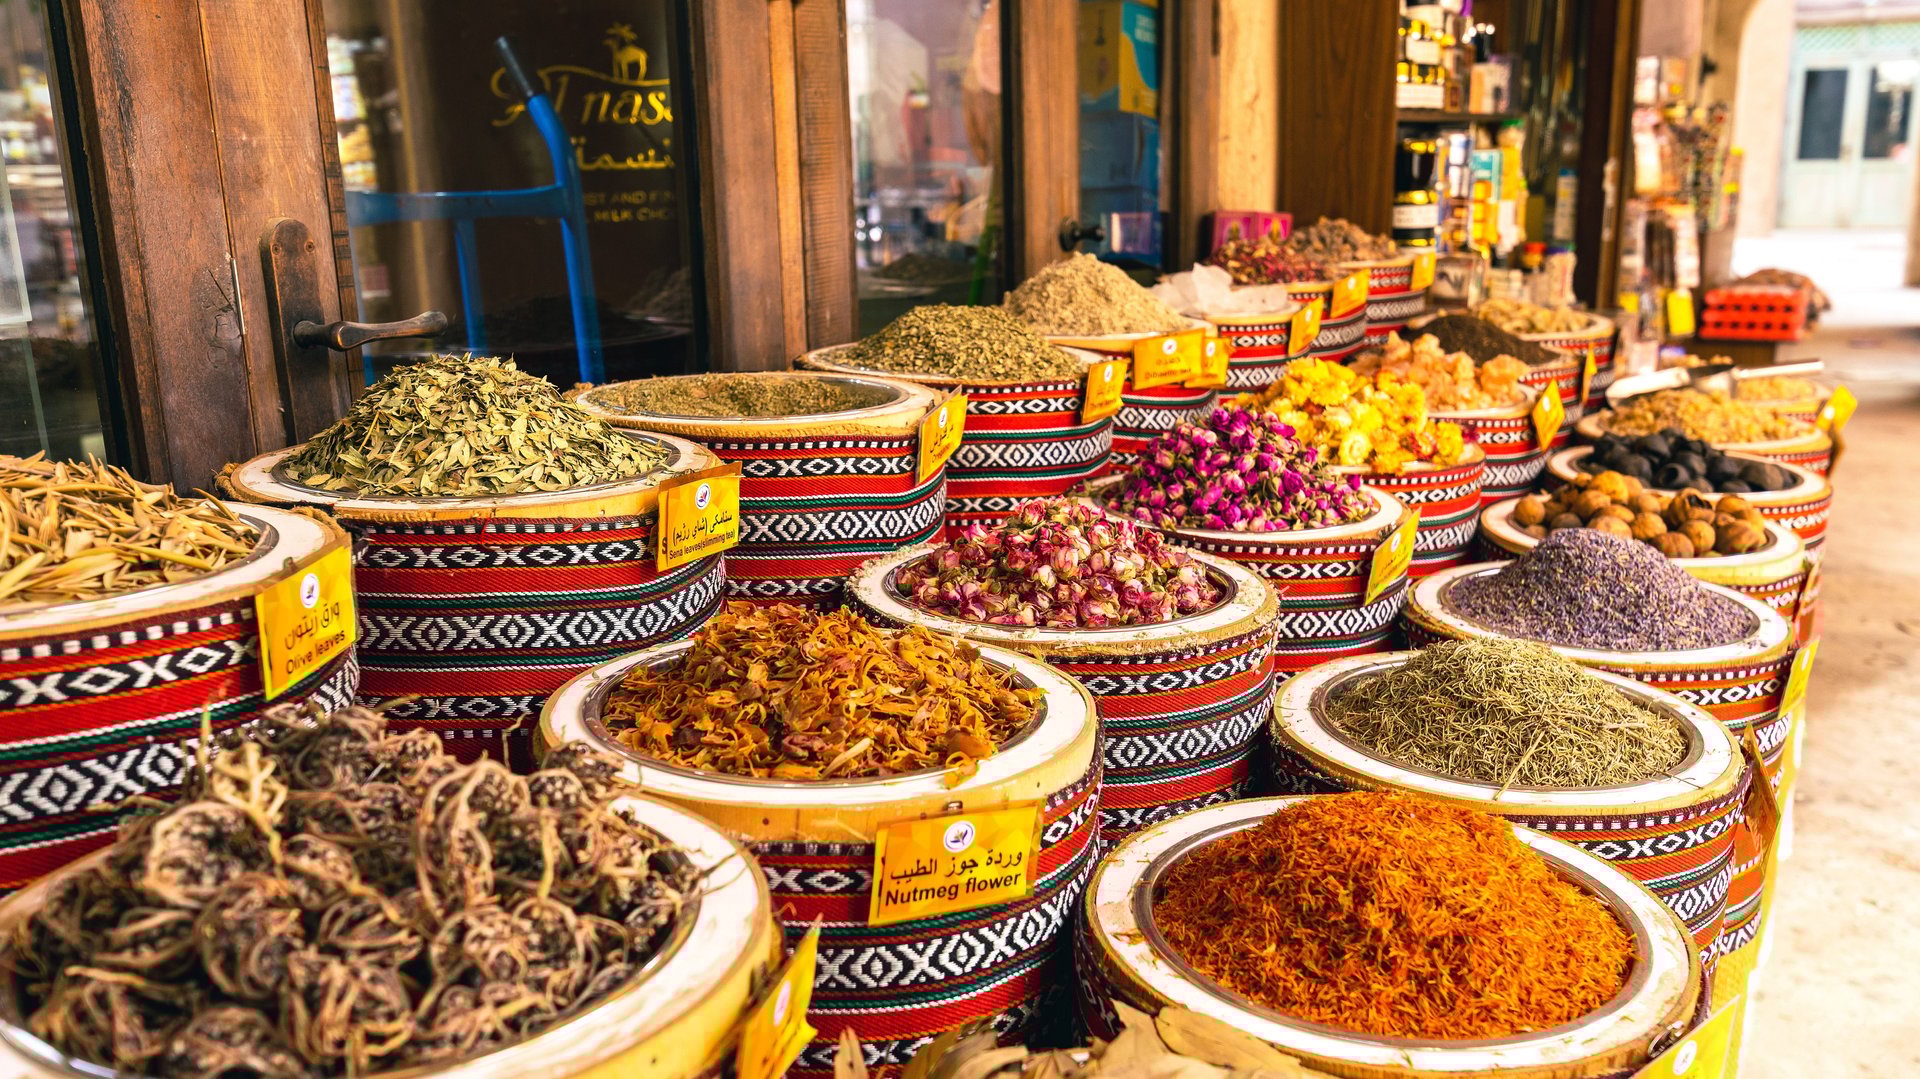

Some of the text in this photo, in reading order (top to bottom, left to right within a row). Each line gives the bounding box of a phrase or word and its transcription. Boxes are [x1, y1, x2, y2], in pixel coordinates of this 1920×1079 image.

[285, 602, 340, 650] ورق زيتون
[286, 630, 345, 675] Olive leaves
[890, 849, 1023, 885] وردة جوز الطيب
[885, 873, 1021, 906] Nutmeg flower
